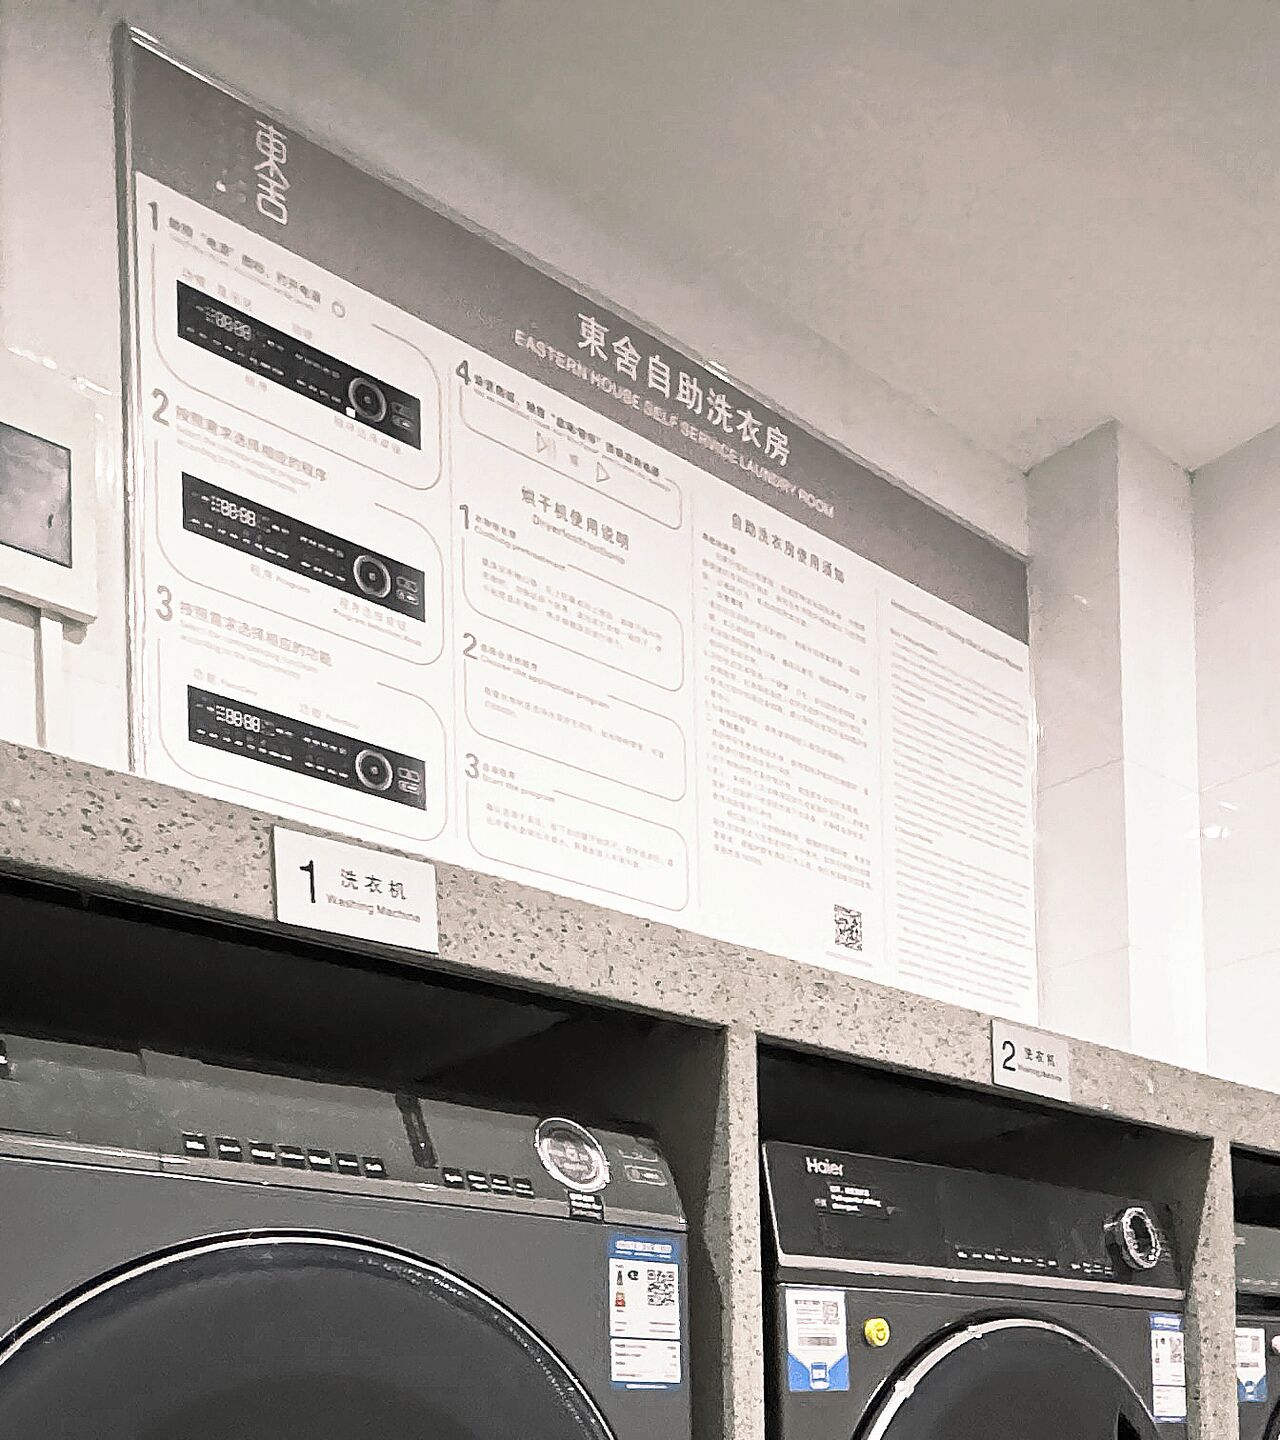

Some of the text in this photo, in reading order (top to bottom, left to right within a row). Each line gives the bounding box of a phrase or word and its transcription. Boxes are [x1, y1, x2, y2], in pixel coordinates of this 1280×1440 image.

[147, 200, 160, 231] 1
[455, 359, 472, 386] 4
[151, 388, 171, 427] 2
[514, 329, 588, 380] EASTERN
[589, 370, 641, 410] HOUSE
[798, 487, 835, 519] ROOM
[459, 504, 470, 530] 1
[154, 585, 174, 622] 3
[462, 632, 479, 660] 2
[464, 752, 481, 780] 3
[299, 859, 317, 904] 1
[341, 867, 407, 900] 洗衣机
[1001, 1040, 1017, 1072] 2
[805, 1156, 844, 1177] Haier
